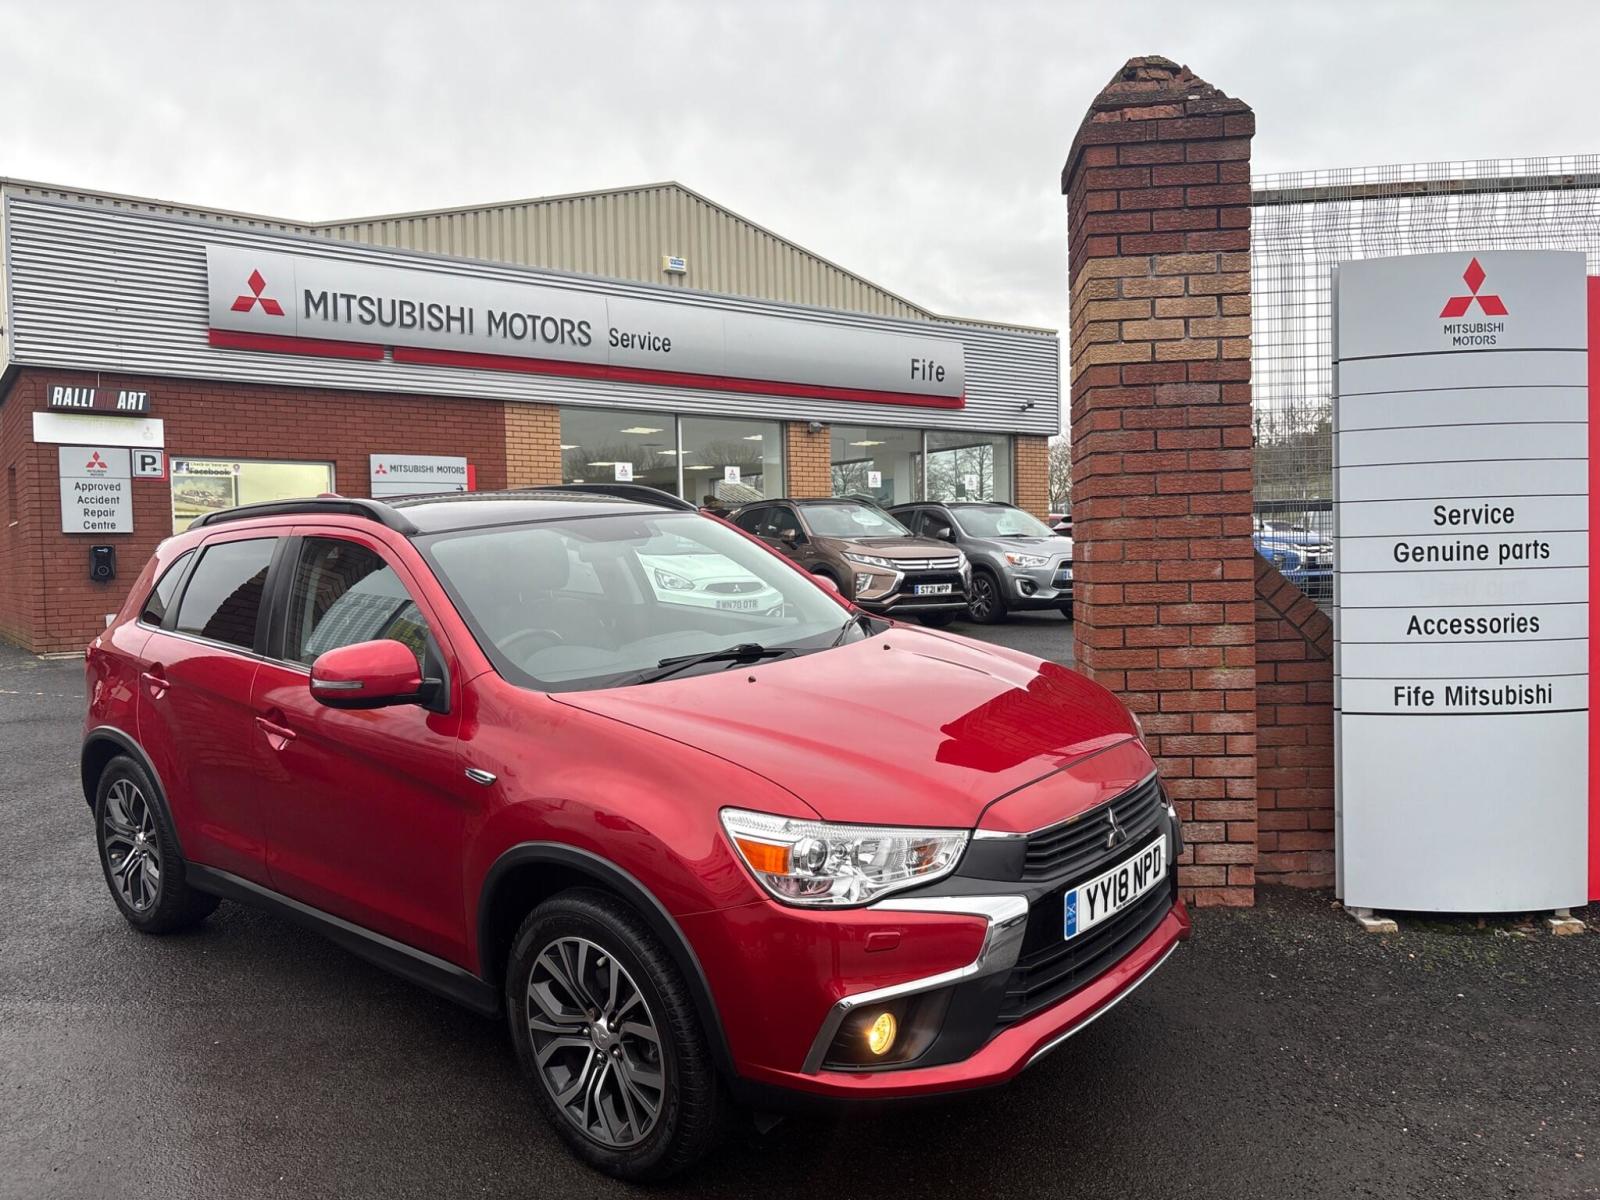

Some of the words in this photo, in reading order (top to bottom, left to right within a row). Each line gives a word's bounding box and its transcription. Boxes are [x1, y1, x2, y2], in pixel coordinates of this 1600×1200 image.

[304, 289, 473, 334] MITSUBISHI
[488, 310, 592, 347] MOTORS
[1444, 322, 1504, 334] MITSUBISHI
[608, 327, 672, 352] Service
[1452, 335, 1496, 346] MOTORS
[911, 358, 945, 382] Fife
[140, 454, 157, 472] P
[389, 464, 434, 473] MITSUBISHI
[436, 466, 465, 474] MOTORS
[74, 482, 121, 492] Approved
[77, 495, 120, 505] Accident
[83, 508, 115, 518] Repair
[1433, 504, 1515, 526] Service
[83, 520, 117, 530] Centre
[1393, 541, 1489, 563] Genuine
[1498, 539, 1550, 565] parts
[1406, 613, 1540, 635] Accessories
[1394, 686, 1434, 706] Fife
[1445, 683, 1552, 706] Mitsubishi
[1086, 868, 1128, 921] YY18
[1133, 844, 1161, 894] NPD
